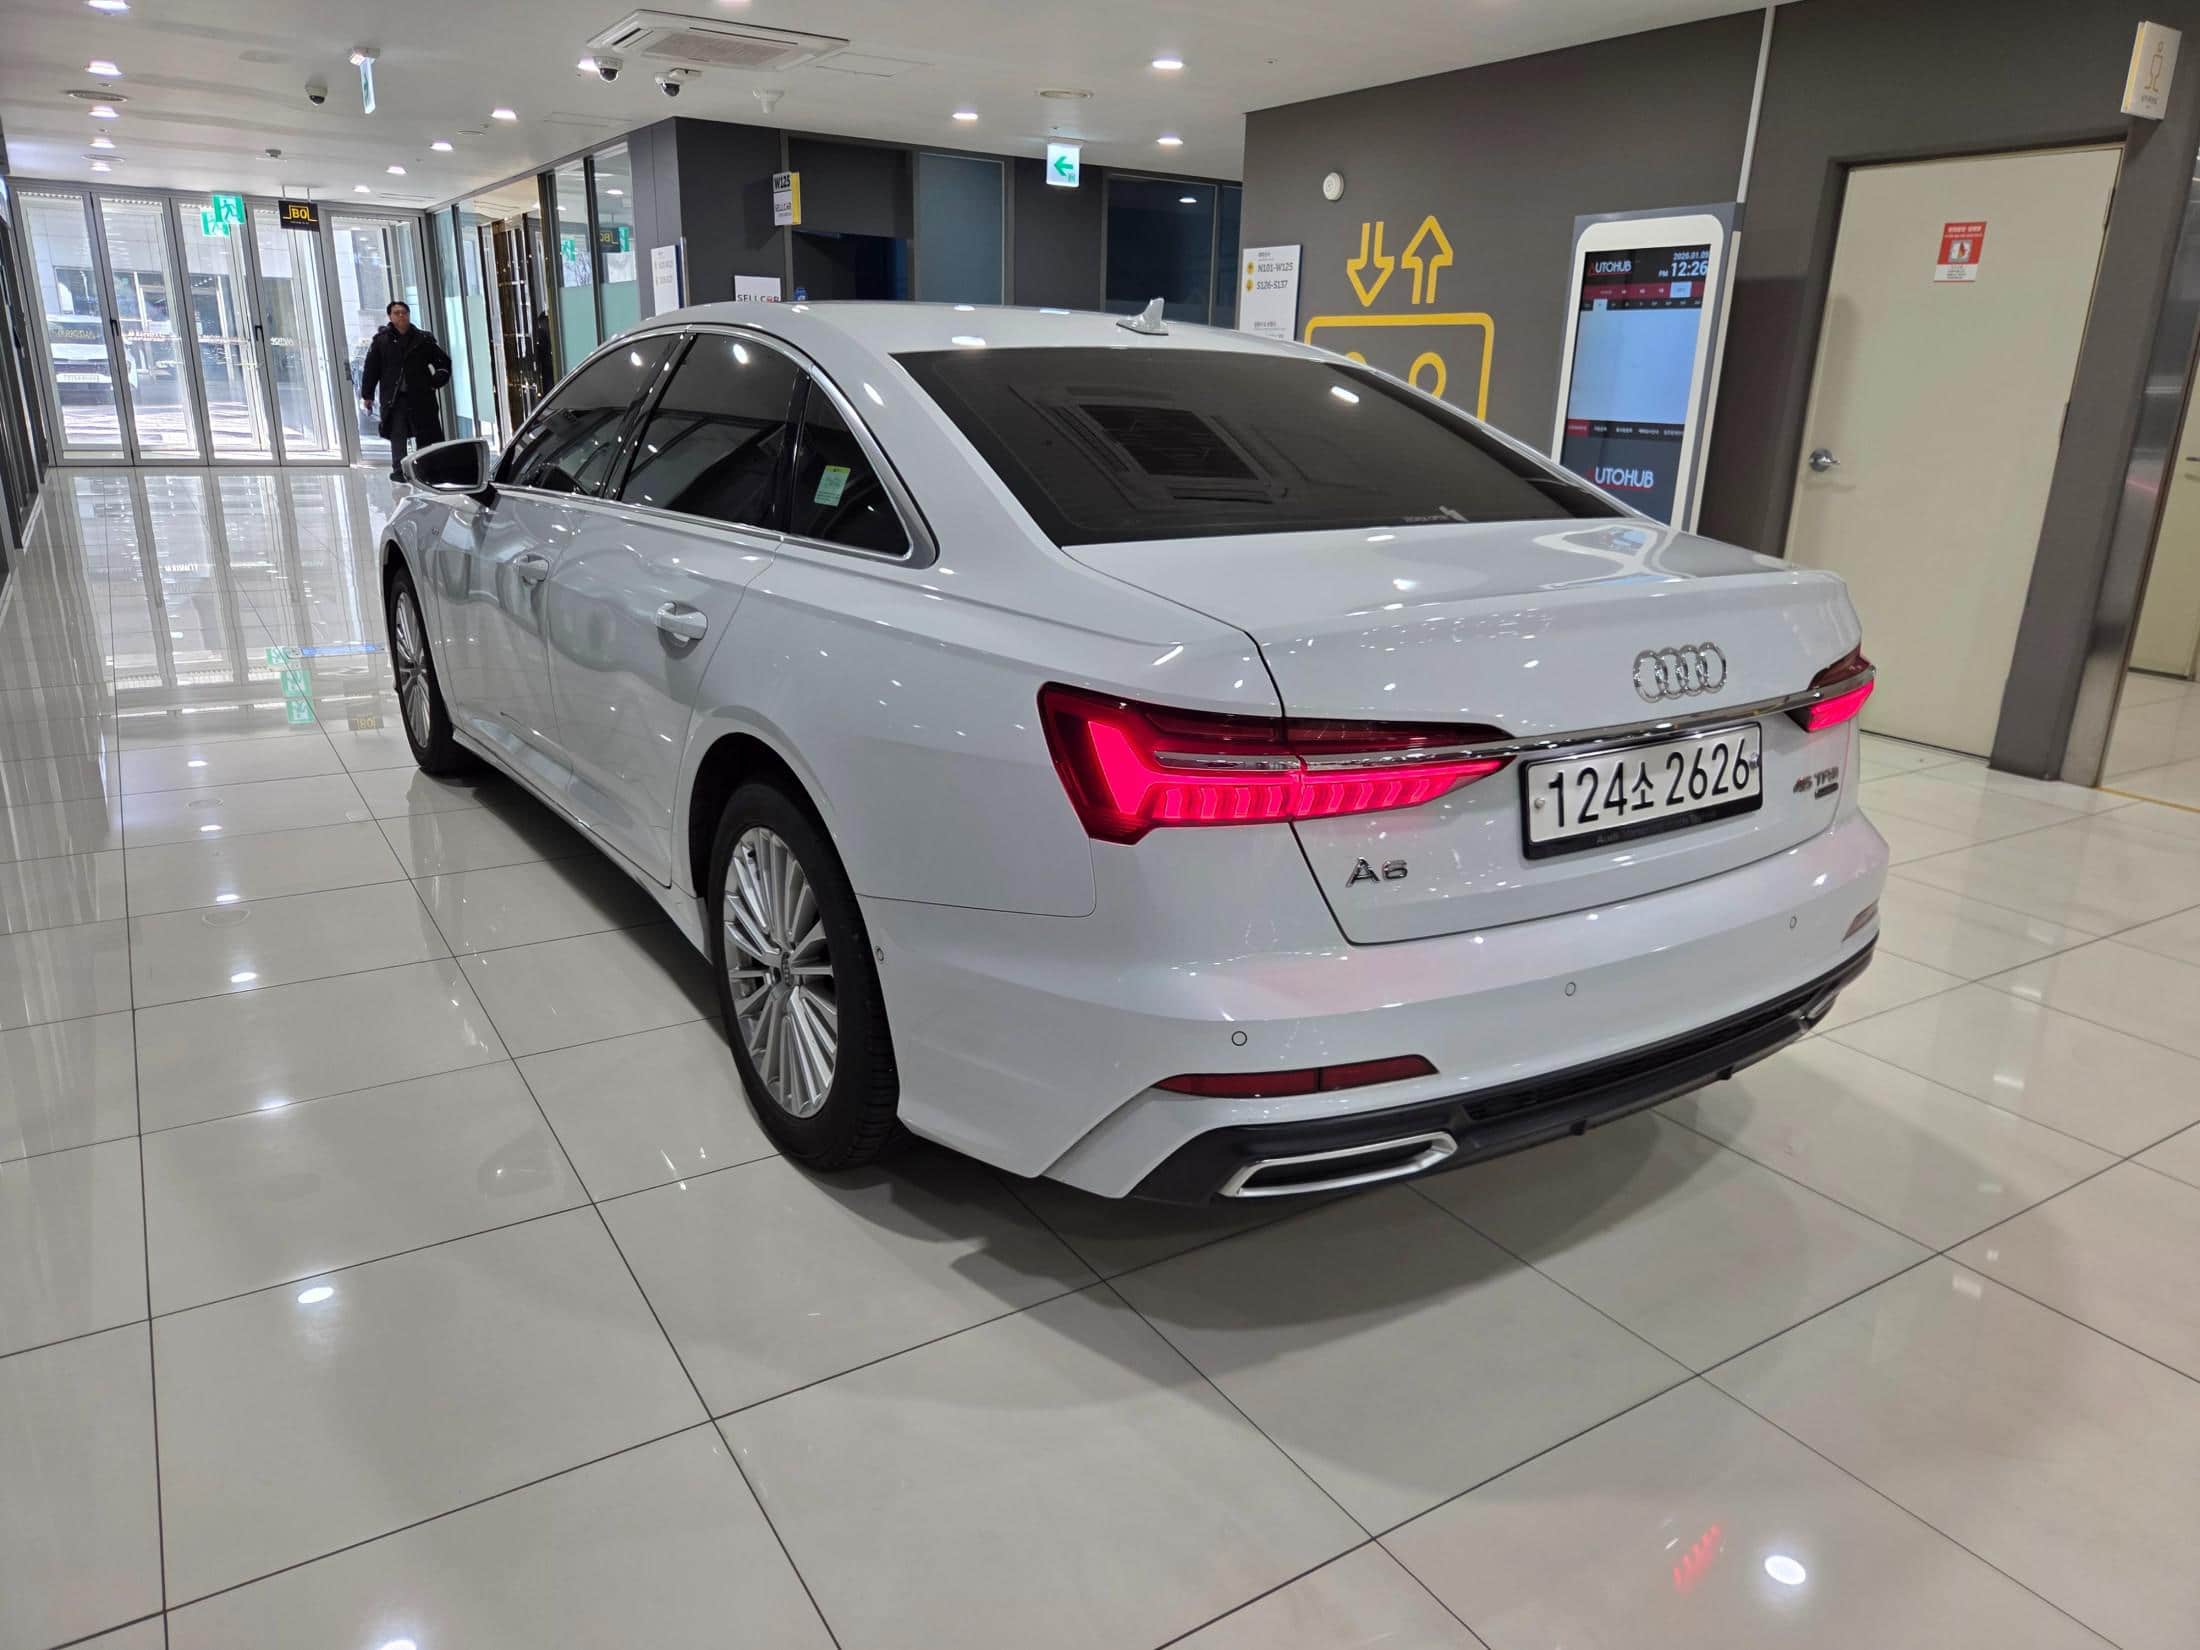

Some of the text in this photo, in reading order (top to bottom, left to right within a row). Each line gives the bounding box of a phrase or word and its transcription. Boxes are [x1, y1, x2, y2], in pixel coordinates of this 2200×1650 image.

[774, 175, 791, 190] W125
[1671, 260, 1708, 277] 12:26
[1549, 760, 1655, 828] 124소
[1665, 737, 1751, 807] 2626
[1345, 856, 1408, 889] A6
